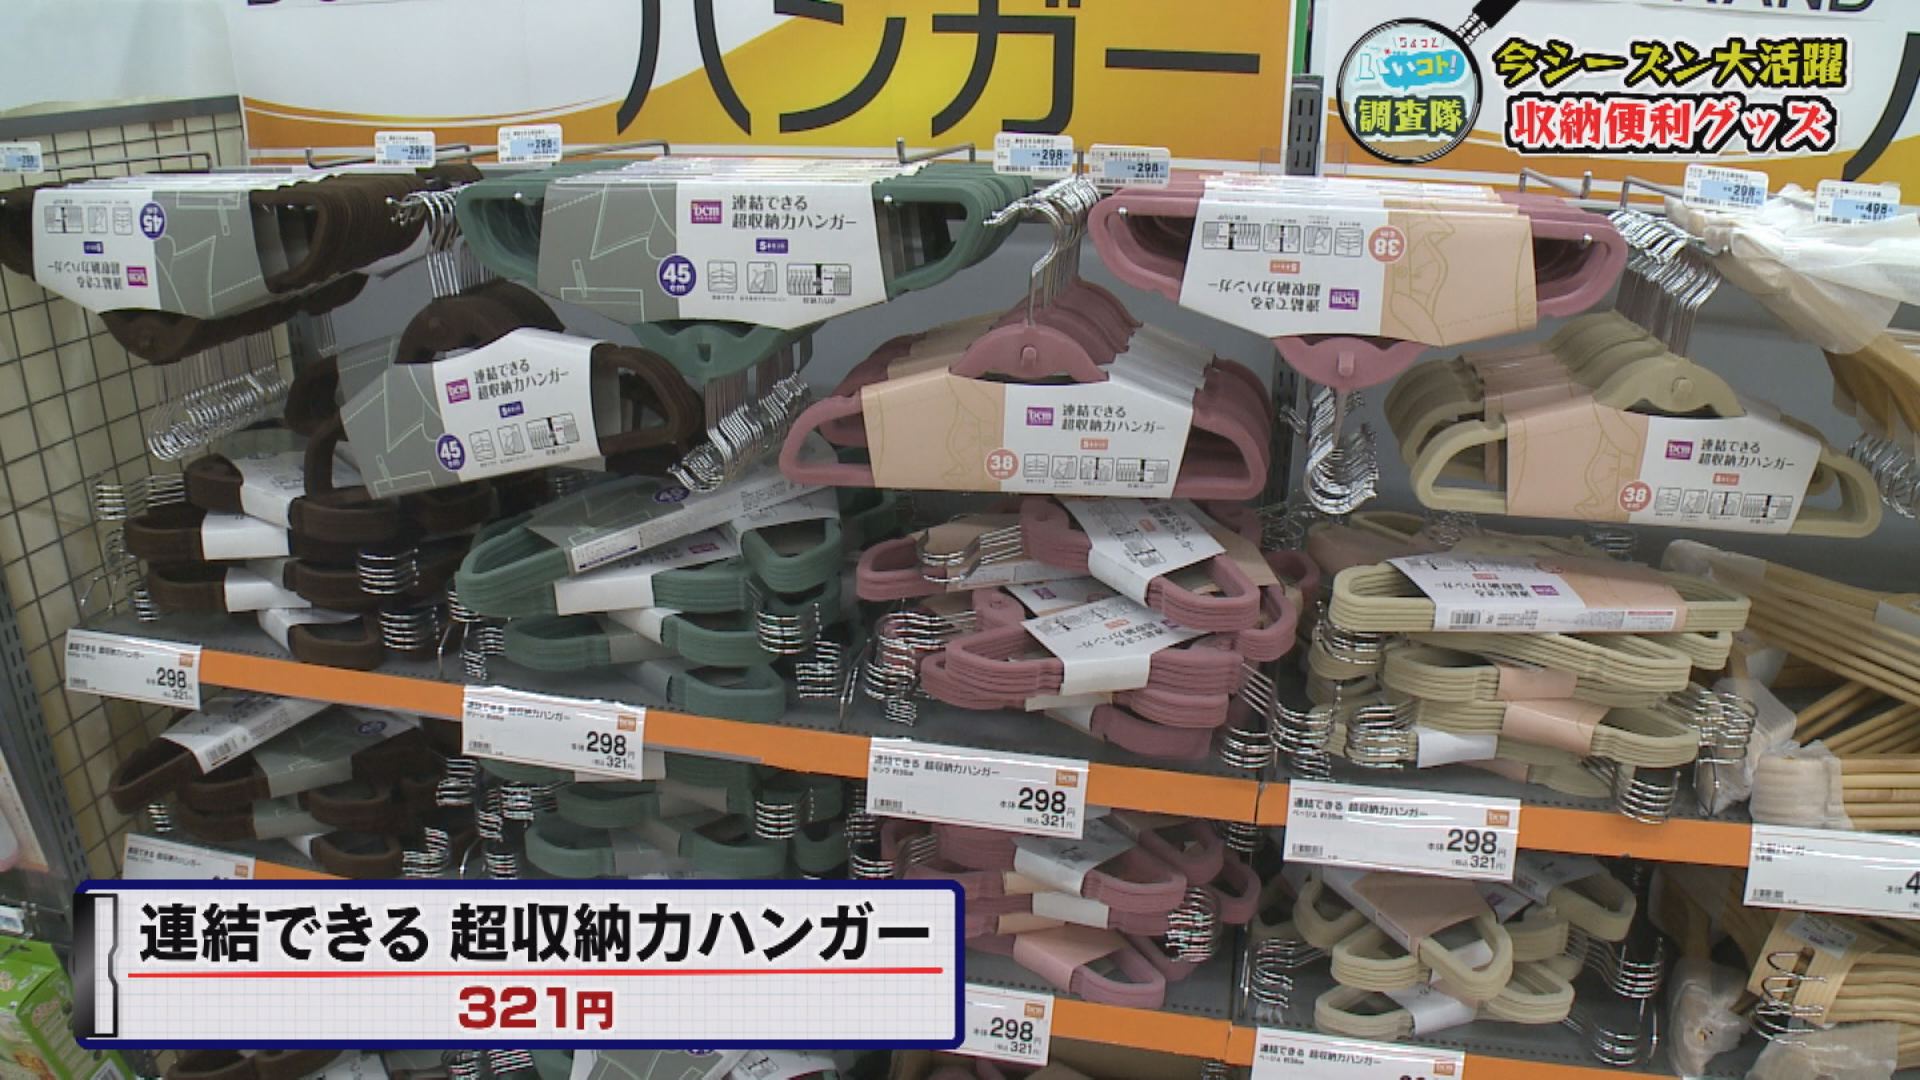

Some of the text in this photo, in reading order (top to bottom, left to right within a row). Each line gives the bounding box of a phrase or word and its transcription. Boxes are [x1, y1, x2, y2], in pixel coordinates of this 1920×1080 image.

[617, 0, 1260, 137] ハンガー
[1042, 148, 1063, 160] 298
[1137, 162, 1158, 172] 298
[732, 195, 808, 211] 連結できる
[1865, 202, 1888, 214] 498
[143, 214, 163, 233] 45
[732, 212, 857, 230] 超収納力ハンガー
[1375, 239, 1399, 256] 38
[663, 263, 691, 284] 45
[1208, 278, 1321, 297] 超収納力ハンガー
[1251, 297, 1320, 313] 連結できる
[474, 359, 530, 384] 連結できる
[478, 368, 569, 400] 超収納力ハンガー
[1062, 404, 1126, 418] 連結できる
[1062, 419, 1165, 433] 超収納力ハンガー
[440, 441, 462, 461] 45
[1701, 439, 1760, 454] 連結できる
[991, 455, 1013, 470] 38
[1699, 453, 1795, 469] 超収納力ハンガー
[1623, 489, 1648, 502] 38
[156, 667, 187, 689] 298
[172, 689, 188, 700] 321
[586, 731, 627, 756] 298
[606, 756, 627, 769] 321
[1018, 787, 1066, 814] 298
[1294, 797, 1343, 810] 連結できる
[1040, 814, 1065, 828] 321
[1446, 829, 1497, 855] 298
[1470, 855, 1496, 869] 321
[990, 1017, 1033, 1042] 298
[1010, 1041, 1032, 1054] 321
